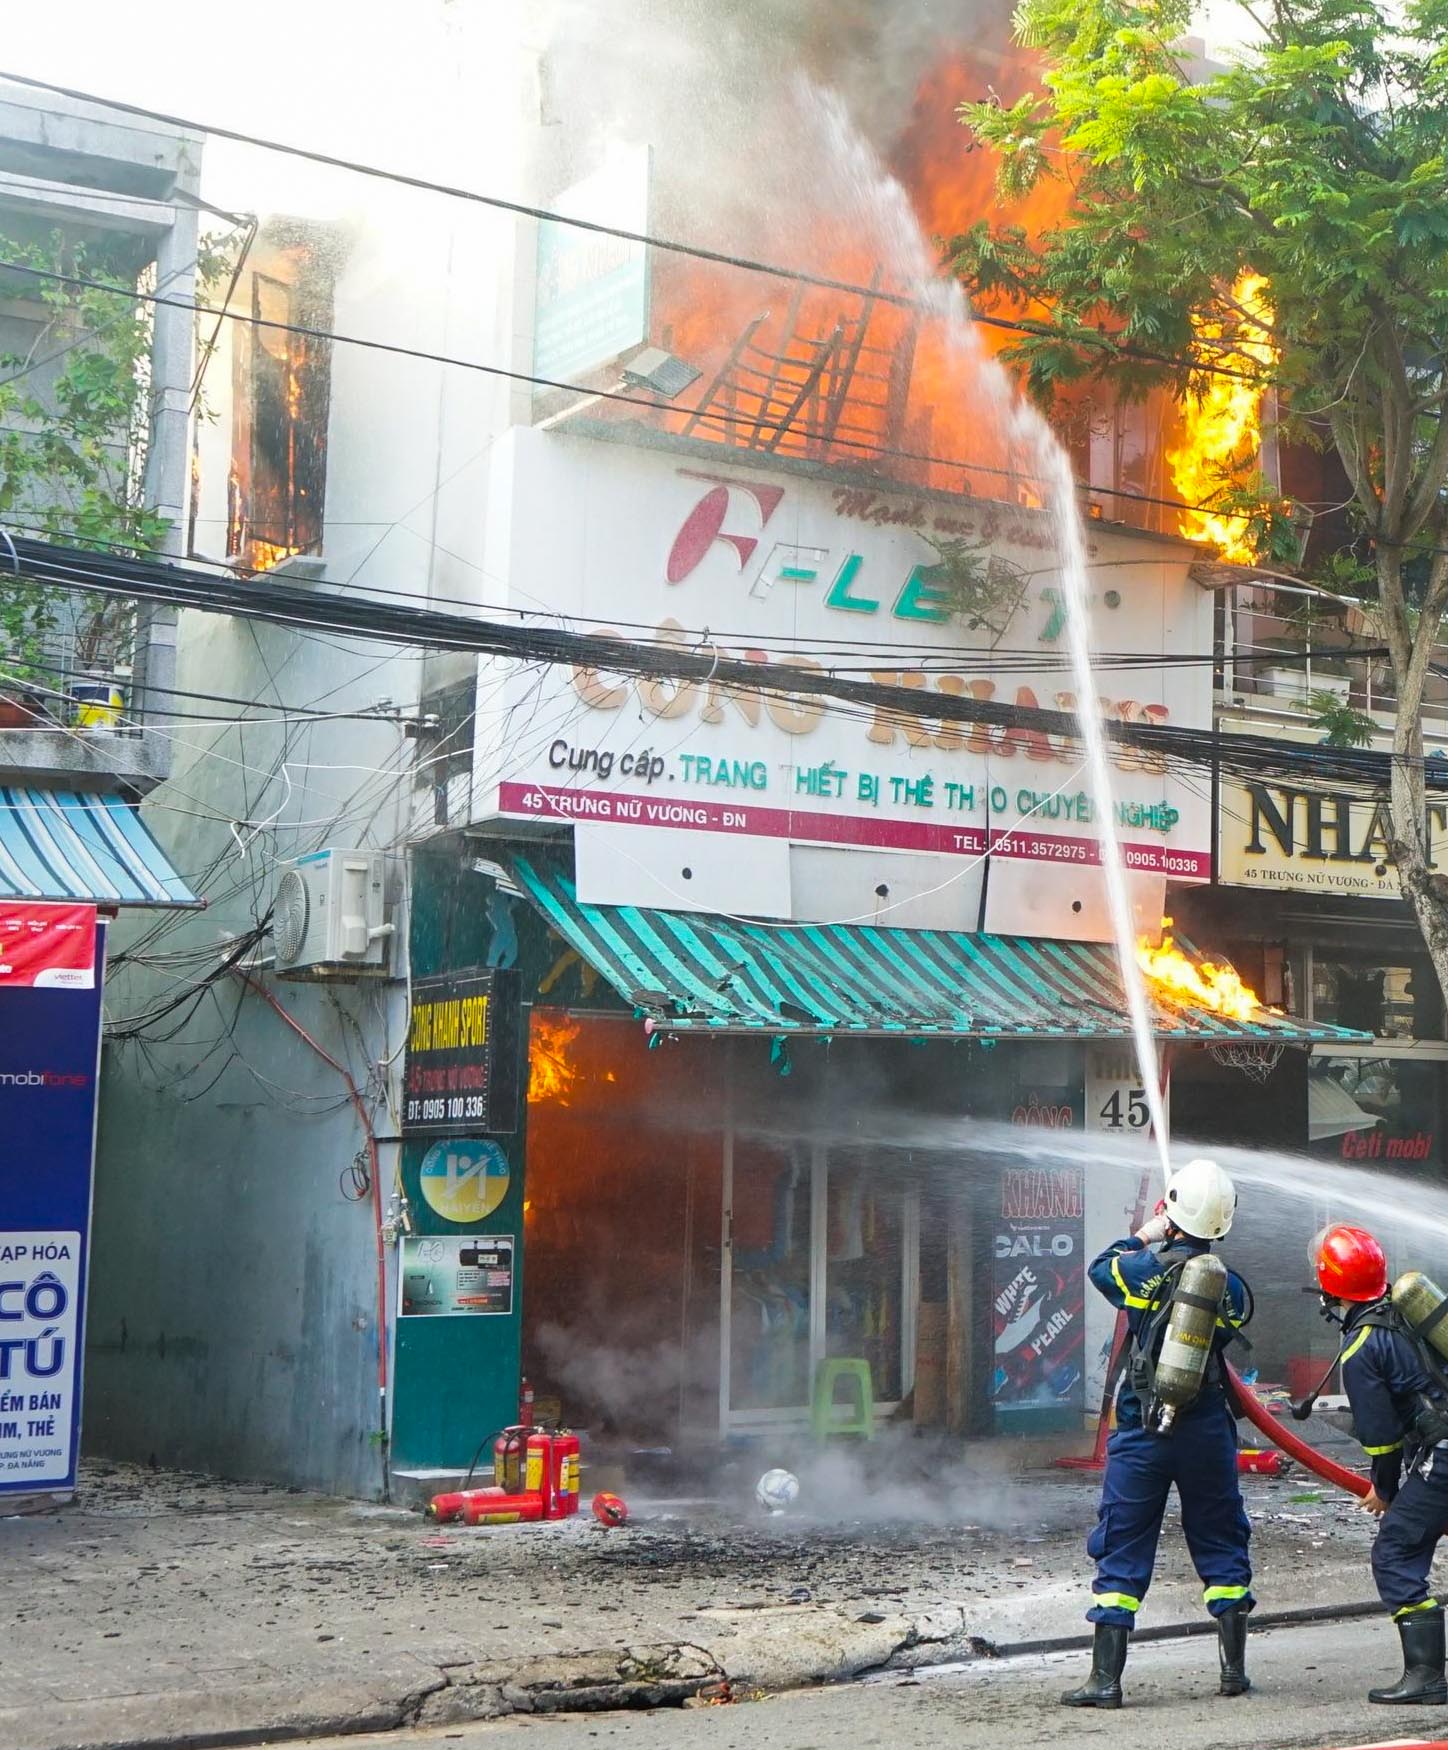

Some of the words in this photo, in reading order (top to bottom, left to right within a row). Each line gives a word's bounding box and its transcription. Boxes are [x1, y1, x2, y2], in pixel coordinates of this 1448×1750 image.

[865, 671, 1169, 776] KHAH
[548, 739, 614, 780] Cung
[679, 753, 768, 790] TRANG
[781, 759, 848, 799] HIẾT
[857, 772, 880, 808] BỊ
[945, 781, 1008, 814] THO
[1016, 790, 1106, 824] CHUYÊ
[522, 792, 543, 809] 45
[550, 796, 611, 816] TRƯNG
[616, 799, 641, 818] NỮ
[647, 804, 707, 824] VƯƠNG
[722, 812, 746, 828] ĐN
[953, 834, 988, 851] TEL:
[1245, 783, 1447, 877] NHẬT
[1244, 868, 1258, 880] 45
[1260, 870, 1304, 883] TRƯNG
[1307, 871, 1325, 884] NỮ
[1328, 875, 1369, 888] VƯƠNG
[460, 994, 488, 1048] SPORT
[408, 1100, 421, 1120] ĐT:
[422, 1098, 445, 1119] 0905
[447, 1096, 464, 1118] 100
[465, 1095, 483, 1118] 336
[1100, 1089, 1150, 1128] 45
[1386, 1130, 1433, 1160] mobi
[0, 1244, 27, 1264] ẠP
[32, 1241, 71, 1261] HÓA
[0, 1271, 69, 1321] CÔ
[994, 1265, 1038, 1316] WHITE
[1029, 1307, 1075, 1357] PEARL
[0, 1327, 65, 1379] TÚ
[0, 1389, 24, 1412] ỂM
[28, 1390, 62, 1411] BÁN
[0, 1421, 22, 1440] IM,
[26, 1414, 55, 1437] THẺ
